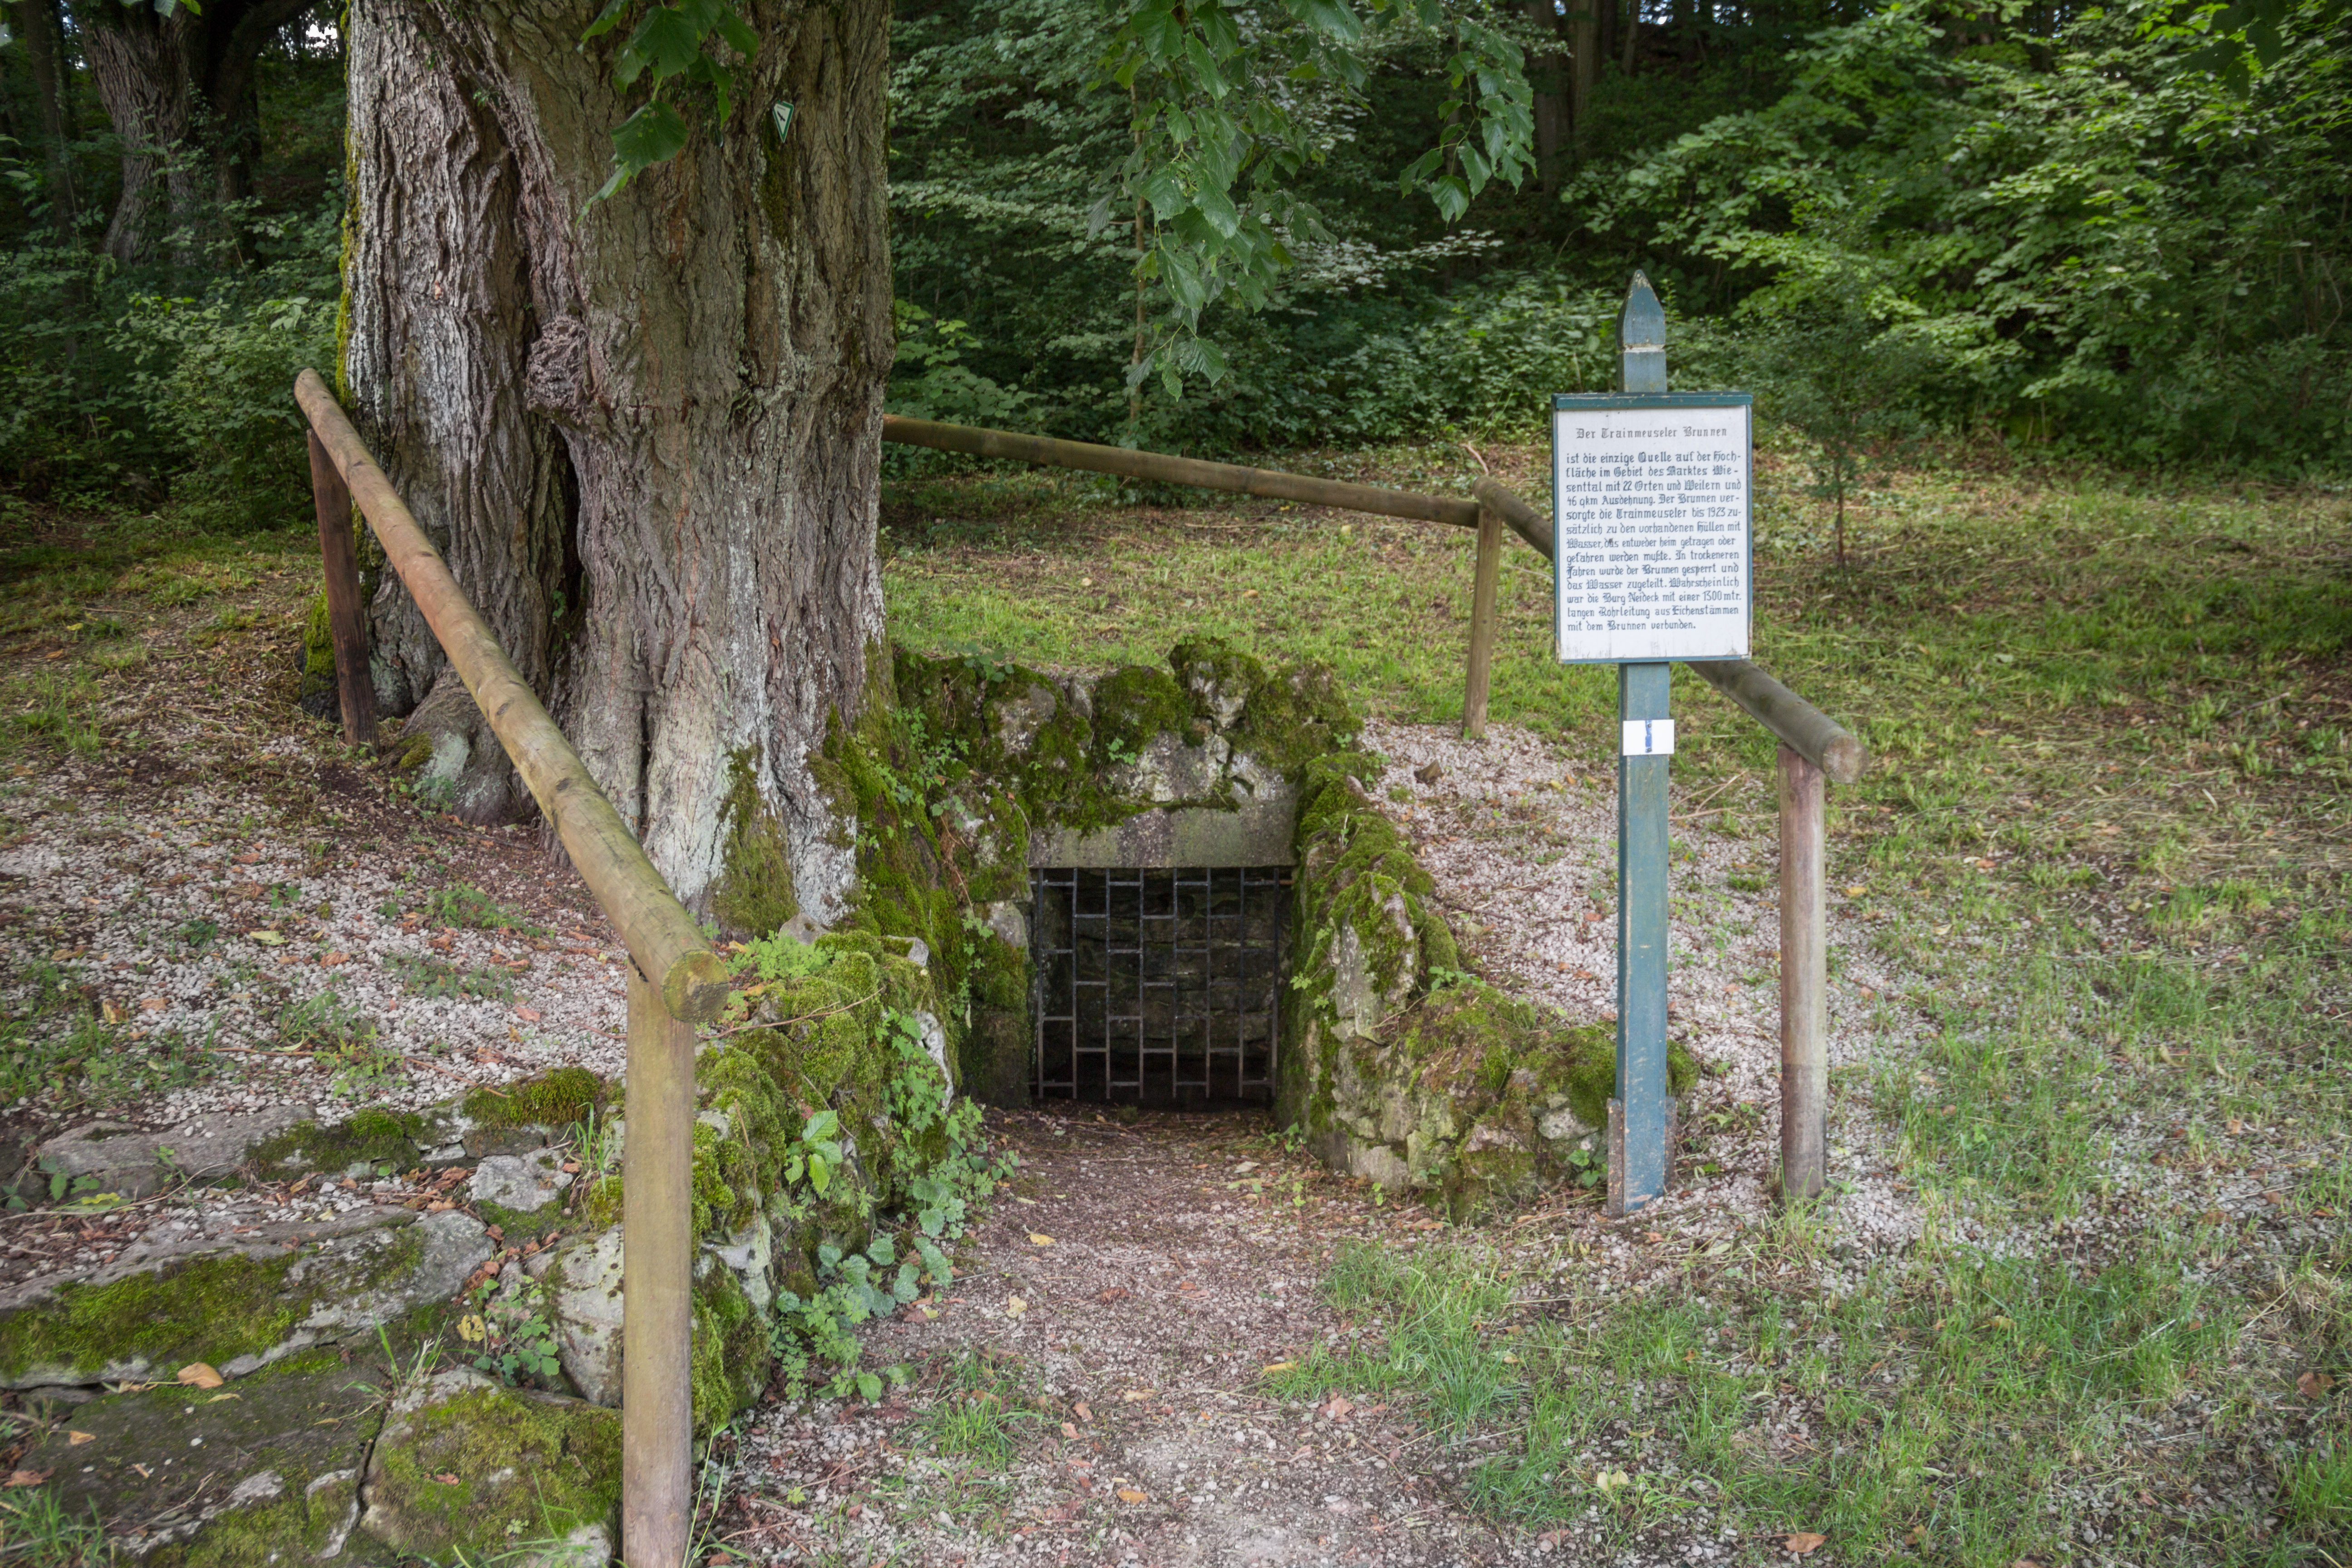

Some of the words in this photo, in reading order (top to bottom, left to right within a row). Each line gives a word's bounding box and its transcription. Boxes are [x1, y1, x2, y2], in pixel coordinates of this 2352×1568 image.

[1576, 428, 1596, 439] Der
[1601, 427, 1677, 438] Trainmeuseler
[1683, 426, 1727, 436] Brunnen
[1567, 453, 1579, 463] ist
[1583, 453, 1597, 463] die
[1601, 452, 1634, 466] einzige
[1638, 451, 1671, 463] Quelle
[1675, 451, 1695, 462] auf
[1697, 451, 1711, 461] der
[1714, 450, 1741, 462] Hoch-
[1566, 467, 1596, 479] fläche
[1600, 467, 1610, 477] im
[1614, 466, 1642, 477] Gebiet
[1649, 466, 1664, 476] des
[1667, 465, 1707, 475] Marktes
[1566, 481, 1602, 492] senttal
[1606, 480, 1620, 491] mit
[1623, 480, 1632, 491] 22
[1635, 480, 1663, 491] Orten
[1667, 480, 1681, 490] und
[1685, 479, 1720, 490] Weilern
[1725, 478, 1741, 490] und
[1567, 496, 1577, 506] 46
[1580, 495, 1597, 508] qkm
[1602, 495, 1655, 506] Ausdehnung.
[1658, 494, 1675, 504] Der
[1677, 493, 1715, 504] Brunnen
[1566, 510, 1595, 522] sorgte
[1599, 509, 1612, 519] die
[1617, 507, 1686, 519] Trainmeuseler
[1692, 507, 1705, 517] bis
[1707, 506, 1725, 517] 1923
[1727, 509, 1742, 517] zu-
[1566, 523, 1602, 535] sätzlich
[1620, 523, 1635, 533] den
[1639, 522, 1694, 534] vorhandenen
[1697, 521, 1724, 534] Hüllen
[1728, 521, 1741, 531] mit
[1604, 538, 1619, 548] das
[1622, 537, 1656, 547] entweder
[1660, 536, 1676, 547] heim
[1681, 536, 1714, 549] getragen
[1718, 535, 1736, 545] oder
[1567, 552, 1604, 566] gefahren
[1609, 551, 1638, 562] werden
[1644, 550, 1671, 563] mußte.
[1675, 549, 1686, 560] In
[1690, 549, 1739, 559] trockeneren
[1567, 566, 1595, 579] Jahren
[1599, 565, 1623, 575] wurde
[1627, 565, 1638, 574] der
[1642, 564, 1678, 574] Brunnen
[1682, 563, 1716, 576] gesperrt
[1721, 562, 1739, 573] und
[1567, 580, 1583, 590] das
[1586, 579, 1623, 589] Wasser
[1627, 578, 1667, 590] zugeteilt.
[1669, 576, 1739, 588] Wahrscheinlich
[1588, 593, 1599, 603] die
[1602, 593, 1625, 605] Burg
[1628, 592, 1659, 602] Neideck
[1662, 592, 1676, 601] mit
[1679, 592, 1700, 601] einer
[1724, 590, 1742, 600] mtr.
[1568, 607, 1594, 620] langen
[1599, 606, 1650, 619] Rohrleitung
[1672, 605, 1739, 616] Eichenstämmen
[1568, 621, 1583, 631] mit
[1586, 621, 1603, 631] dem
[1607, 620, 1646, 631] Brunnen
[1651, 618, 1696, 629] verbunden.
